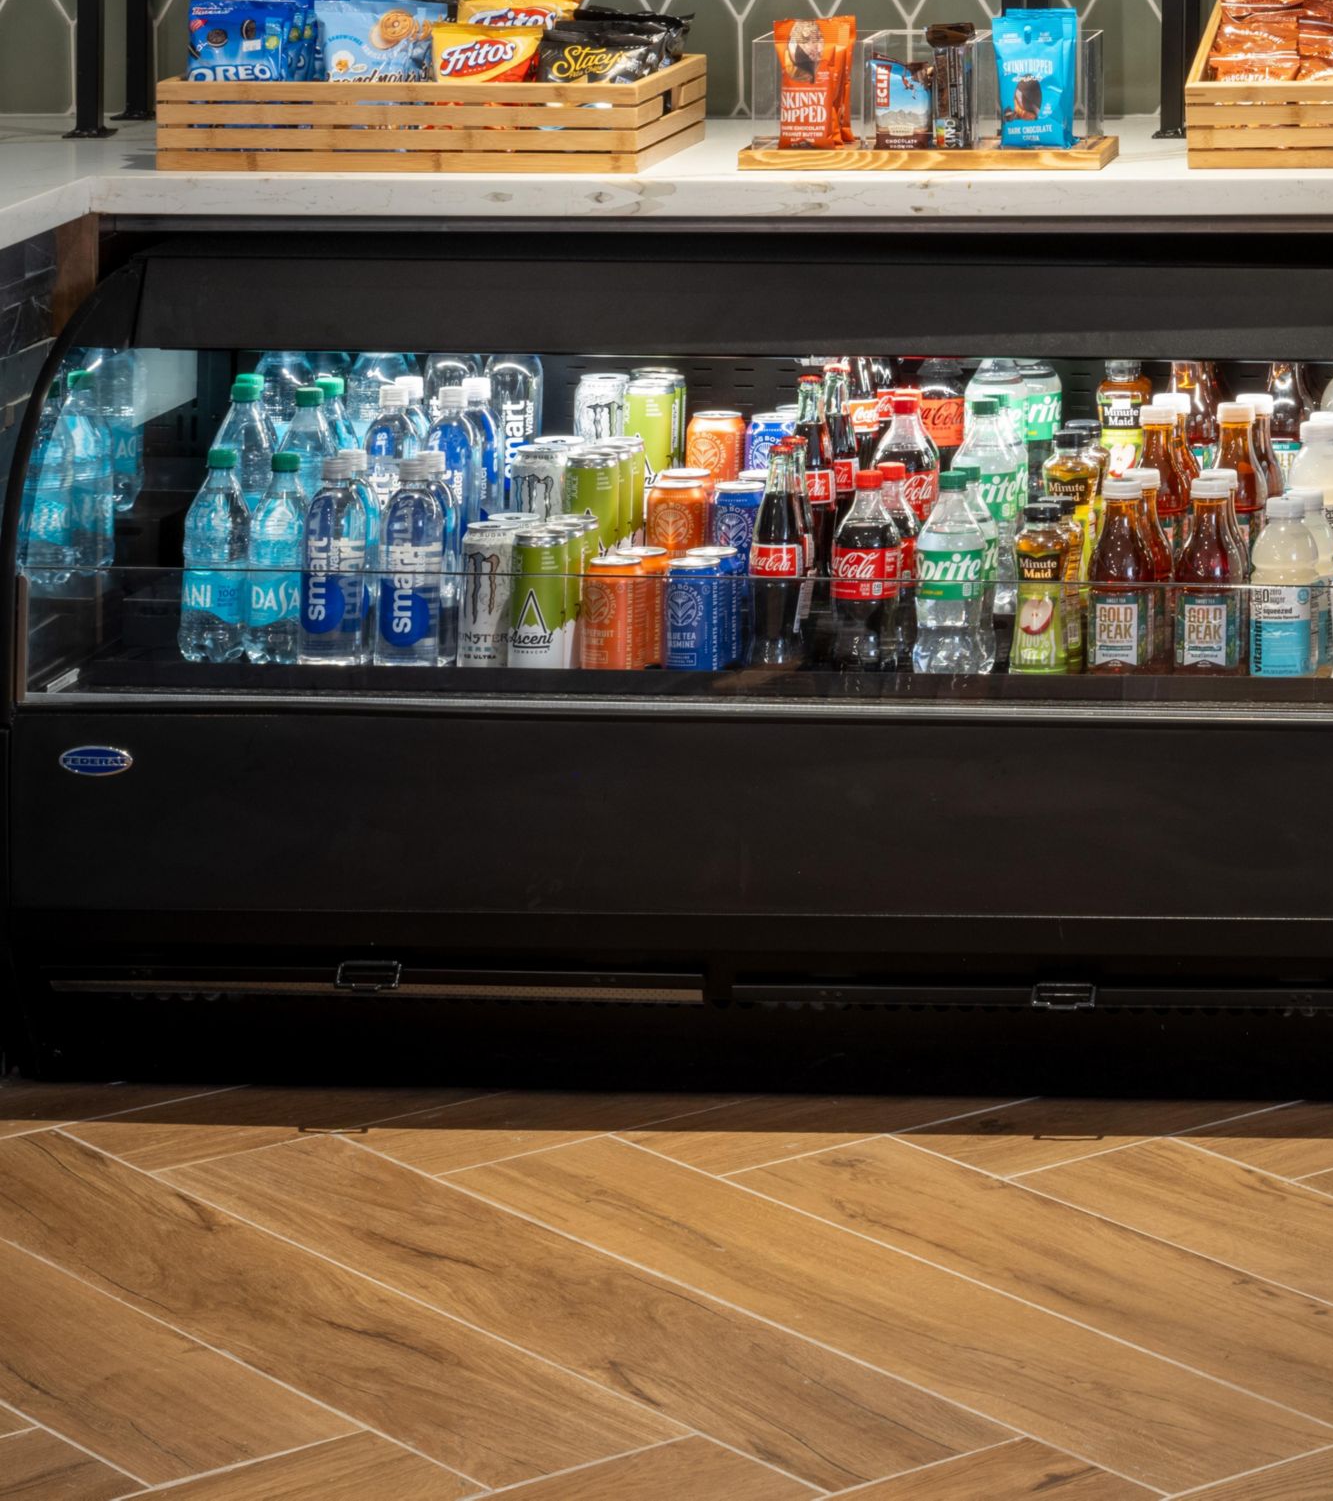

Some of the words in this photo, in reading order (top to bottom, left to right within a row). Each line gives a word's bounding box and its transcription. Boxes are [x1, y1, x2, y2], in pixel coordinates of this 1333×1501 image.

[468, 10, 556, 29] Fritos
[441, 42, 516, 76] Fritos
[552, 46, 624, 78] Stacy's
[190, 64, 271, 81] OREO
[877, 67, 888, 98] CLIF
[781, 92, 827, 108] SKINNY
[781, 107, 826, 122] DIPPED
[1023, 125, 1052, 134] CHOCOLATE
[524, 401, 534, 436] water
[1104, 407, 1139, 417] Minute
[1108, 416, 1134, 426] Maid
[1050, 483, 1085, 491] Minute
[329, 539, 340, 572] water
[1019, 557, 1057, 569] Minute
[917, 553, 981, 581] Sprite
[1023, 568, 1052, 579] Maid
[308, 537, 329, 621] smart
[393, 545, 415, 633] smart
[1263, 589, 1269, 602] 0
[1100, 607, 1133, 623] GOLD
[1188, 607, 1222, 623] GOLD
[1263, 607, 1292, 615] squeezed
[1100, 624, 1133, 639] PEAK
[1188, 624, 1222, 640] PEAK
[1254, 589, 1262, 673] vitaminwater
[510, 630, 553, 649] Ascent
